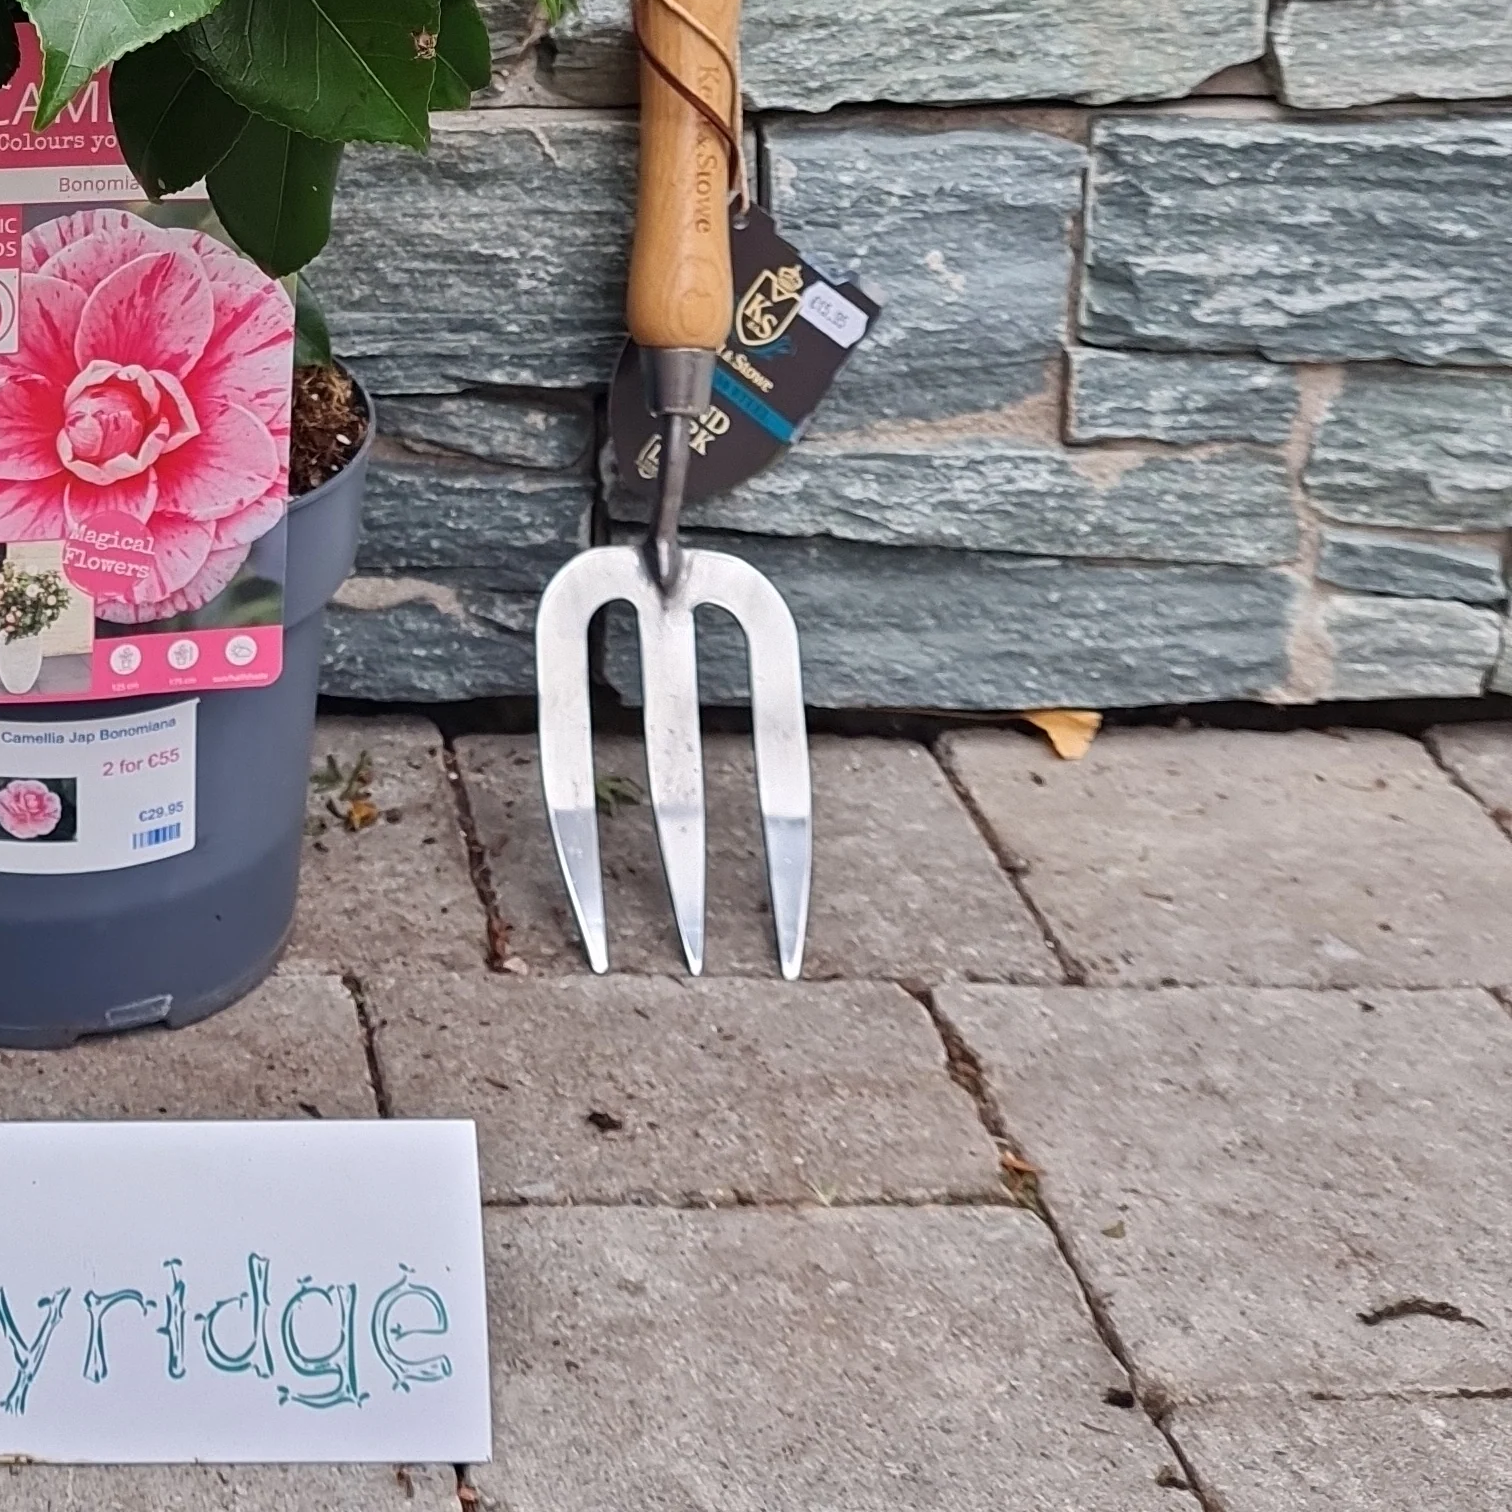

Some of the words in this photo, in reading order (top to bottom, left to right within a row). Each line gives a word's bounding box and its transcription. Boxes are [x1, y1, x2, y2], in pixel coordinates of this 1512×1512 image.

[695, 154, 718, 234] Stowe
[729, 353, 774, 393] Stowe
[69, 522, 155, 555] Magical
[62, 547, 149, 578] Flowers
[1, 731, 65, 745] Camellia
[69, 731, 95, 745] Jap
[100, 716, 176, 741] Bonomiana
[103, 761, 114, 777] 2
[119, 758, 144, 774] for
[147, 747, 180, 769] €55
[139, 800, 184, 823] €29.95
